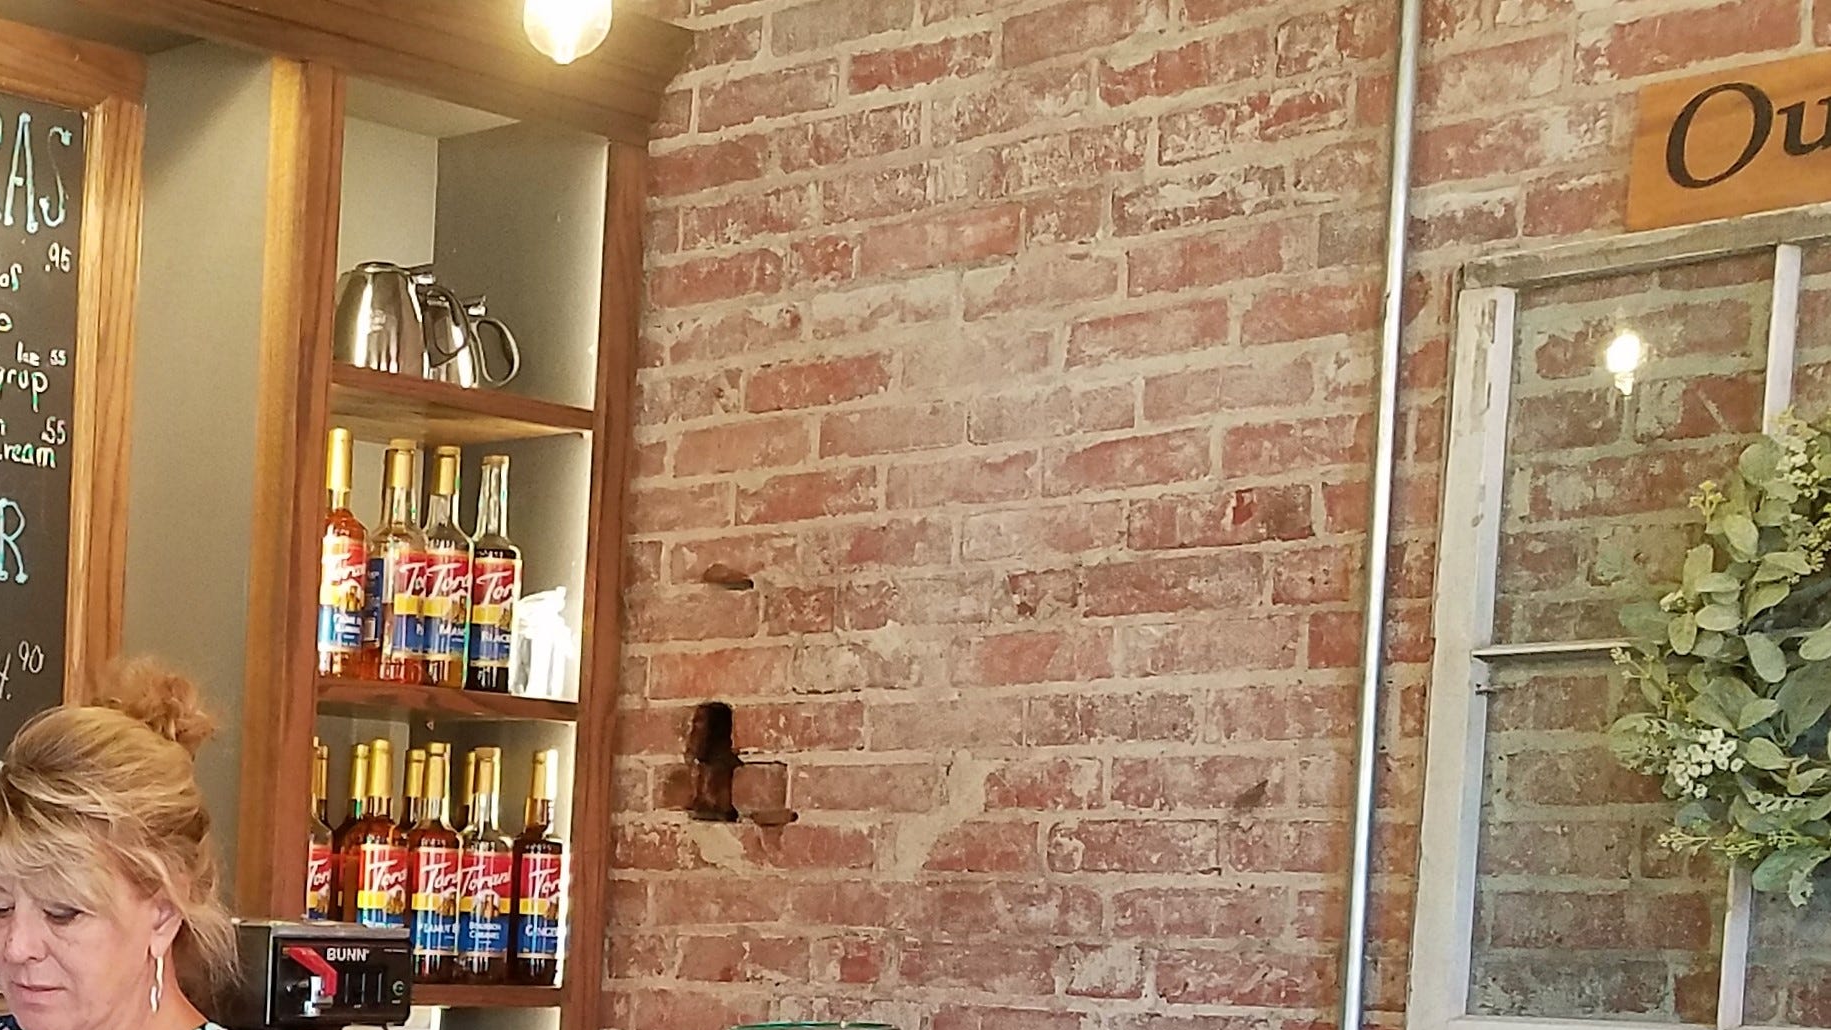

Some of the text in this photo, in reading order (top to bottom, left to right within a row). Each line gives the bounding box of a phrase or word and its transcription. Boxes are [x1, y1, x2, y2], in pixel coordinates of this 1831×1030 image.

[1665, 82, 1831, 190] Ou
[43, 241, 72, 274] .95
[326, 947, 369, 963] BUNN
